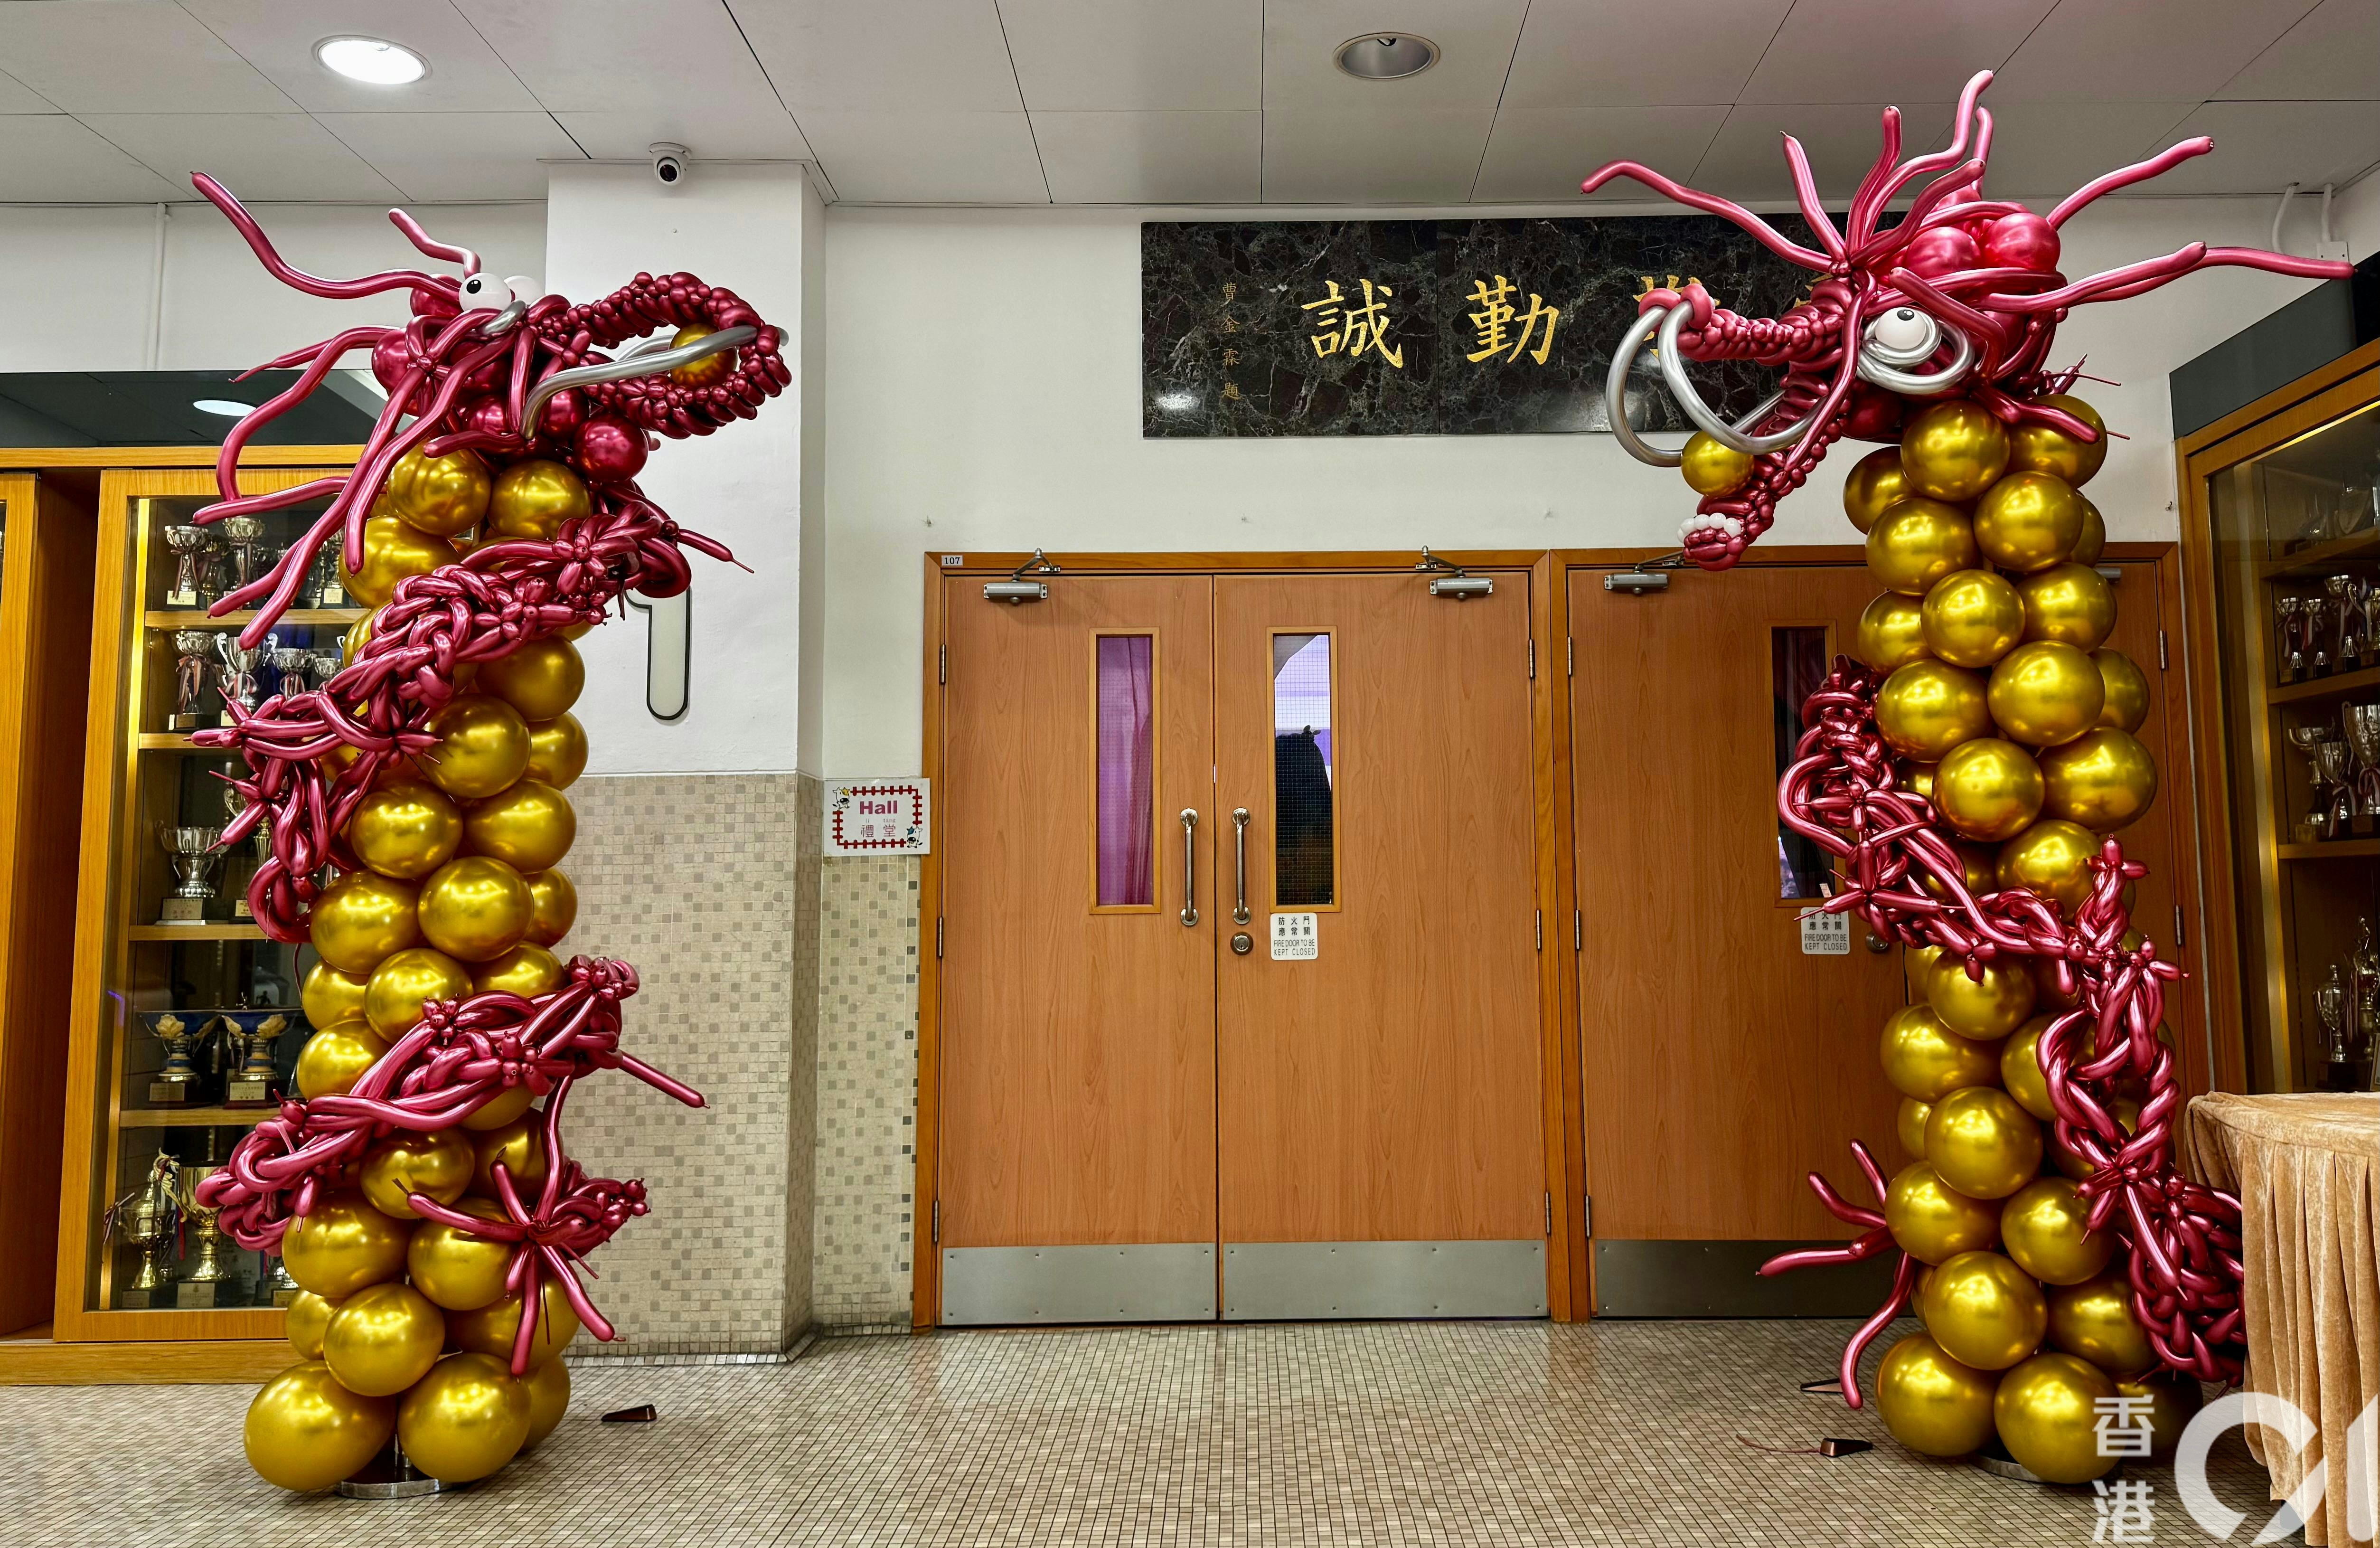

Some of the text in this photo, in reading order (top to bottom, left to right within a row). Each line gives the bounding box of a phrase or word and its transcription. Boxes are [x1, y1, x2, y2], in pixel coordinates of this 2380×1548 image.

[860, 801, 897, 814] Hall
[861, 824, 896, 837] 禮堂
[1279, 916, 1310, 925] 防火門
[1816, 934, 1831, 942] DOOR
[1832, 934, 1839, 942] TO
